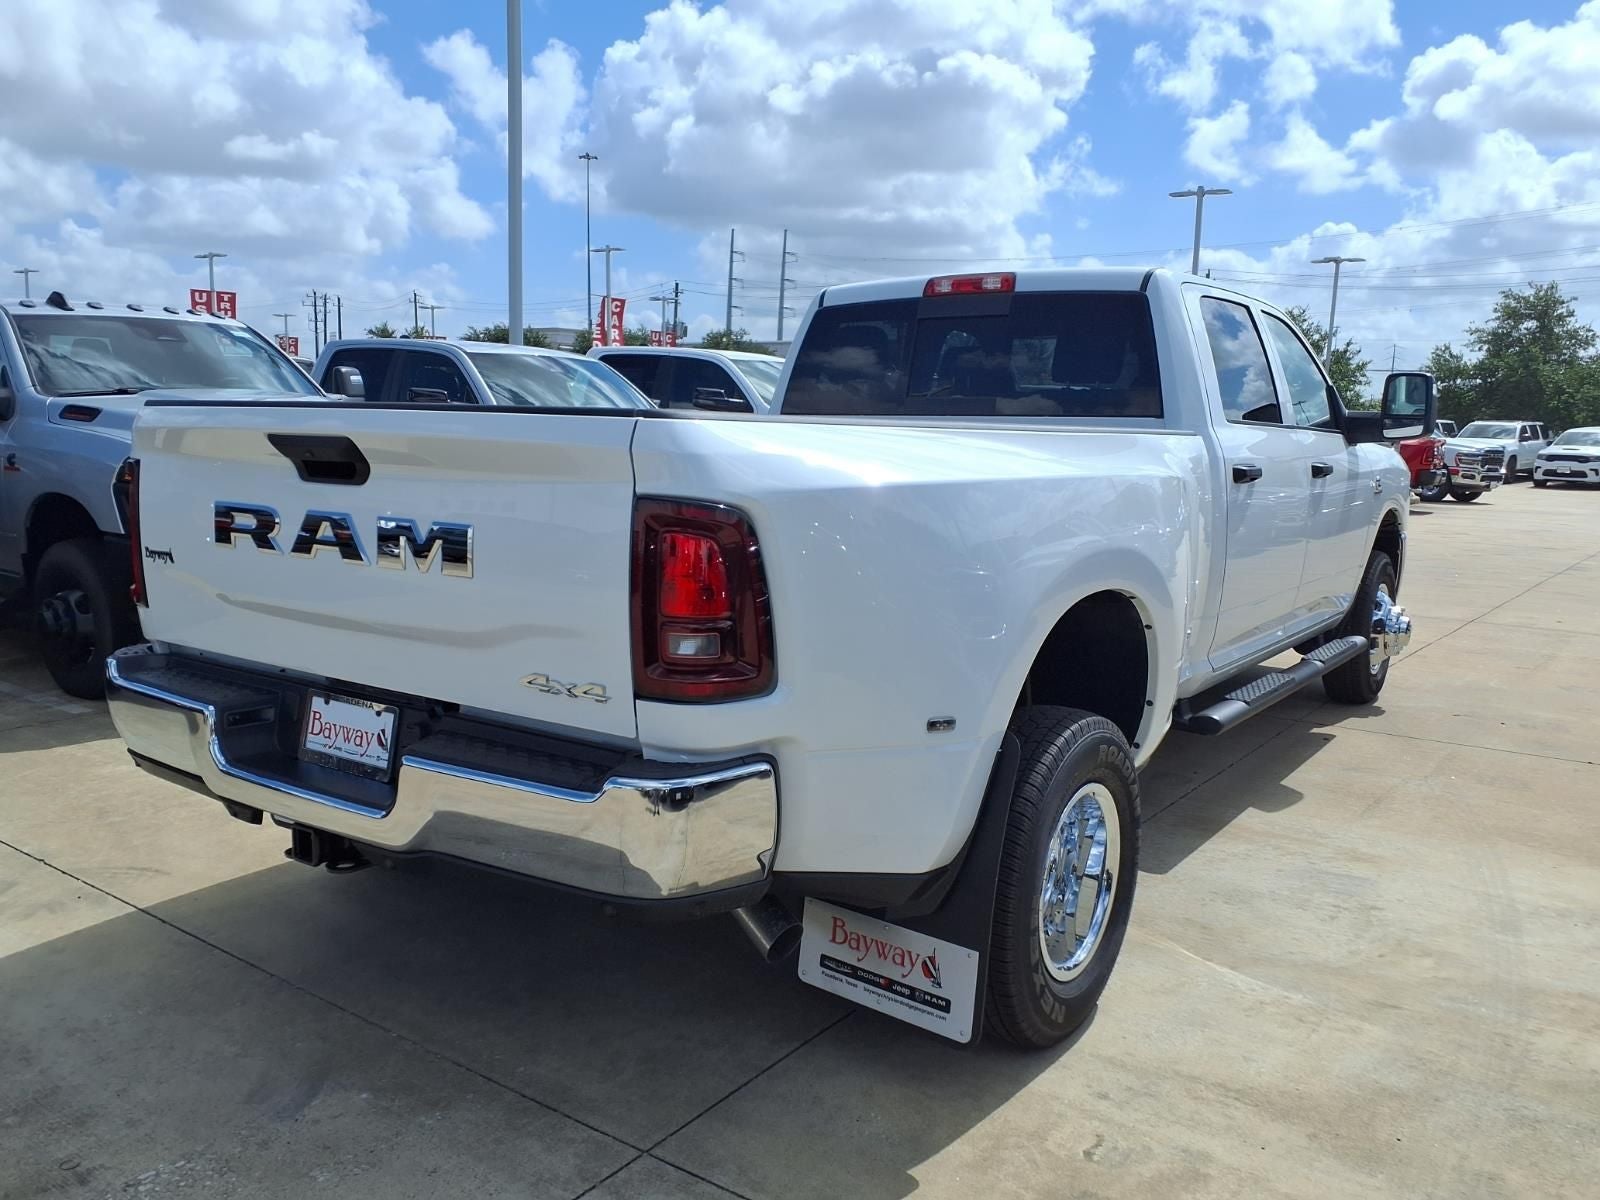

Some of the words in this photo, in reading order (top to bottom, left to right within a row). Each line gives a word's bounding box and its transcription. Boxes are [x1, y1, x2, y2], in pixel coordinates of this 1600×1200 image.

[144, 546, 170, 564] Bayway
[213, 500, 474, 579] RAM
[309, 710, 375, 757] Bayway
[828, 916, 920, 978] Bayway
[892, 983, 911, 996] Jeep
[924, 994, 946, 1007] RAM
